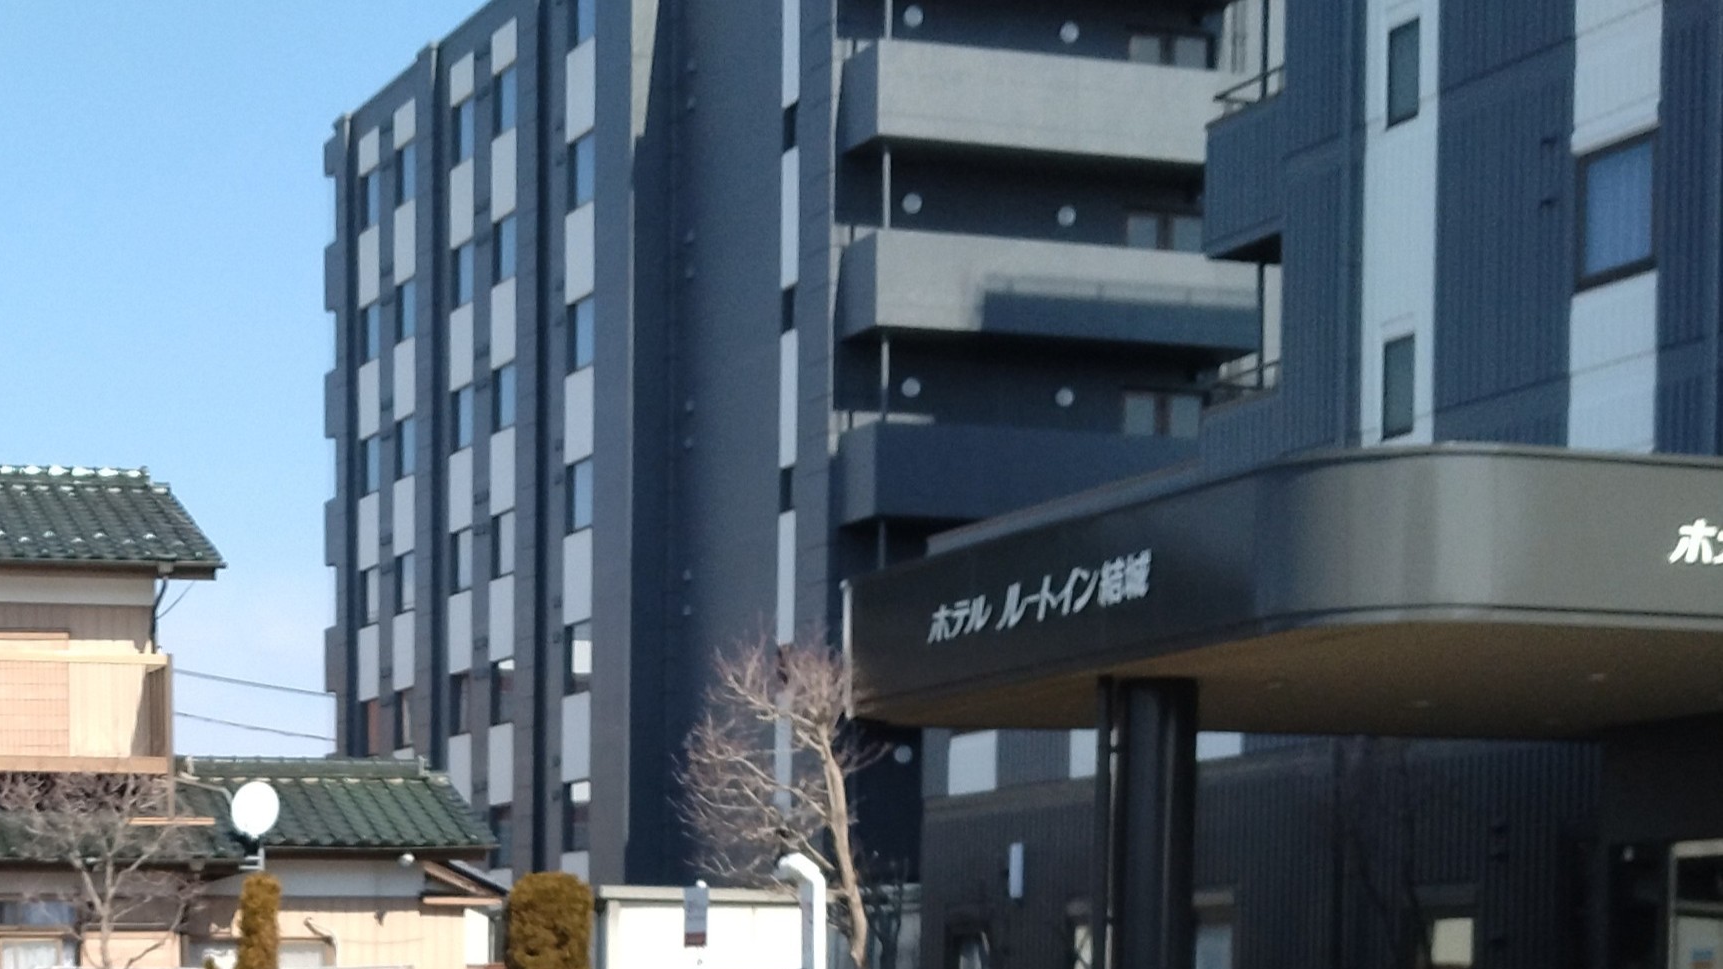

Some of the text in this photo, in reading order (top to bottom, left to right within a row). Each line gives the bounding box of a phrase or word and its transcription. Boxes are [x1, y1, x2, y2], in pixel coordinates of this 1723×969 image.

[1669, 518, 1723, 564] ホ
[928, 594, 992, 643] ホテル
